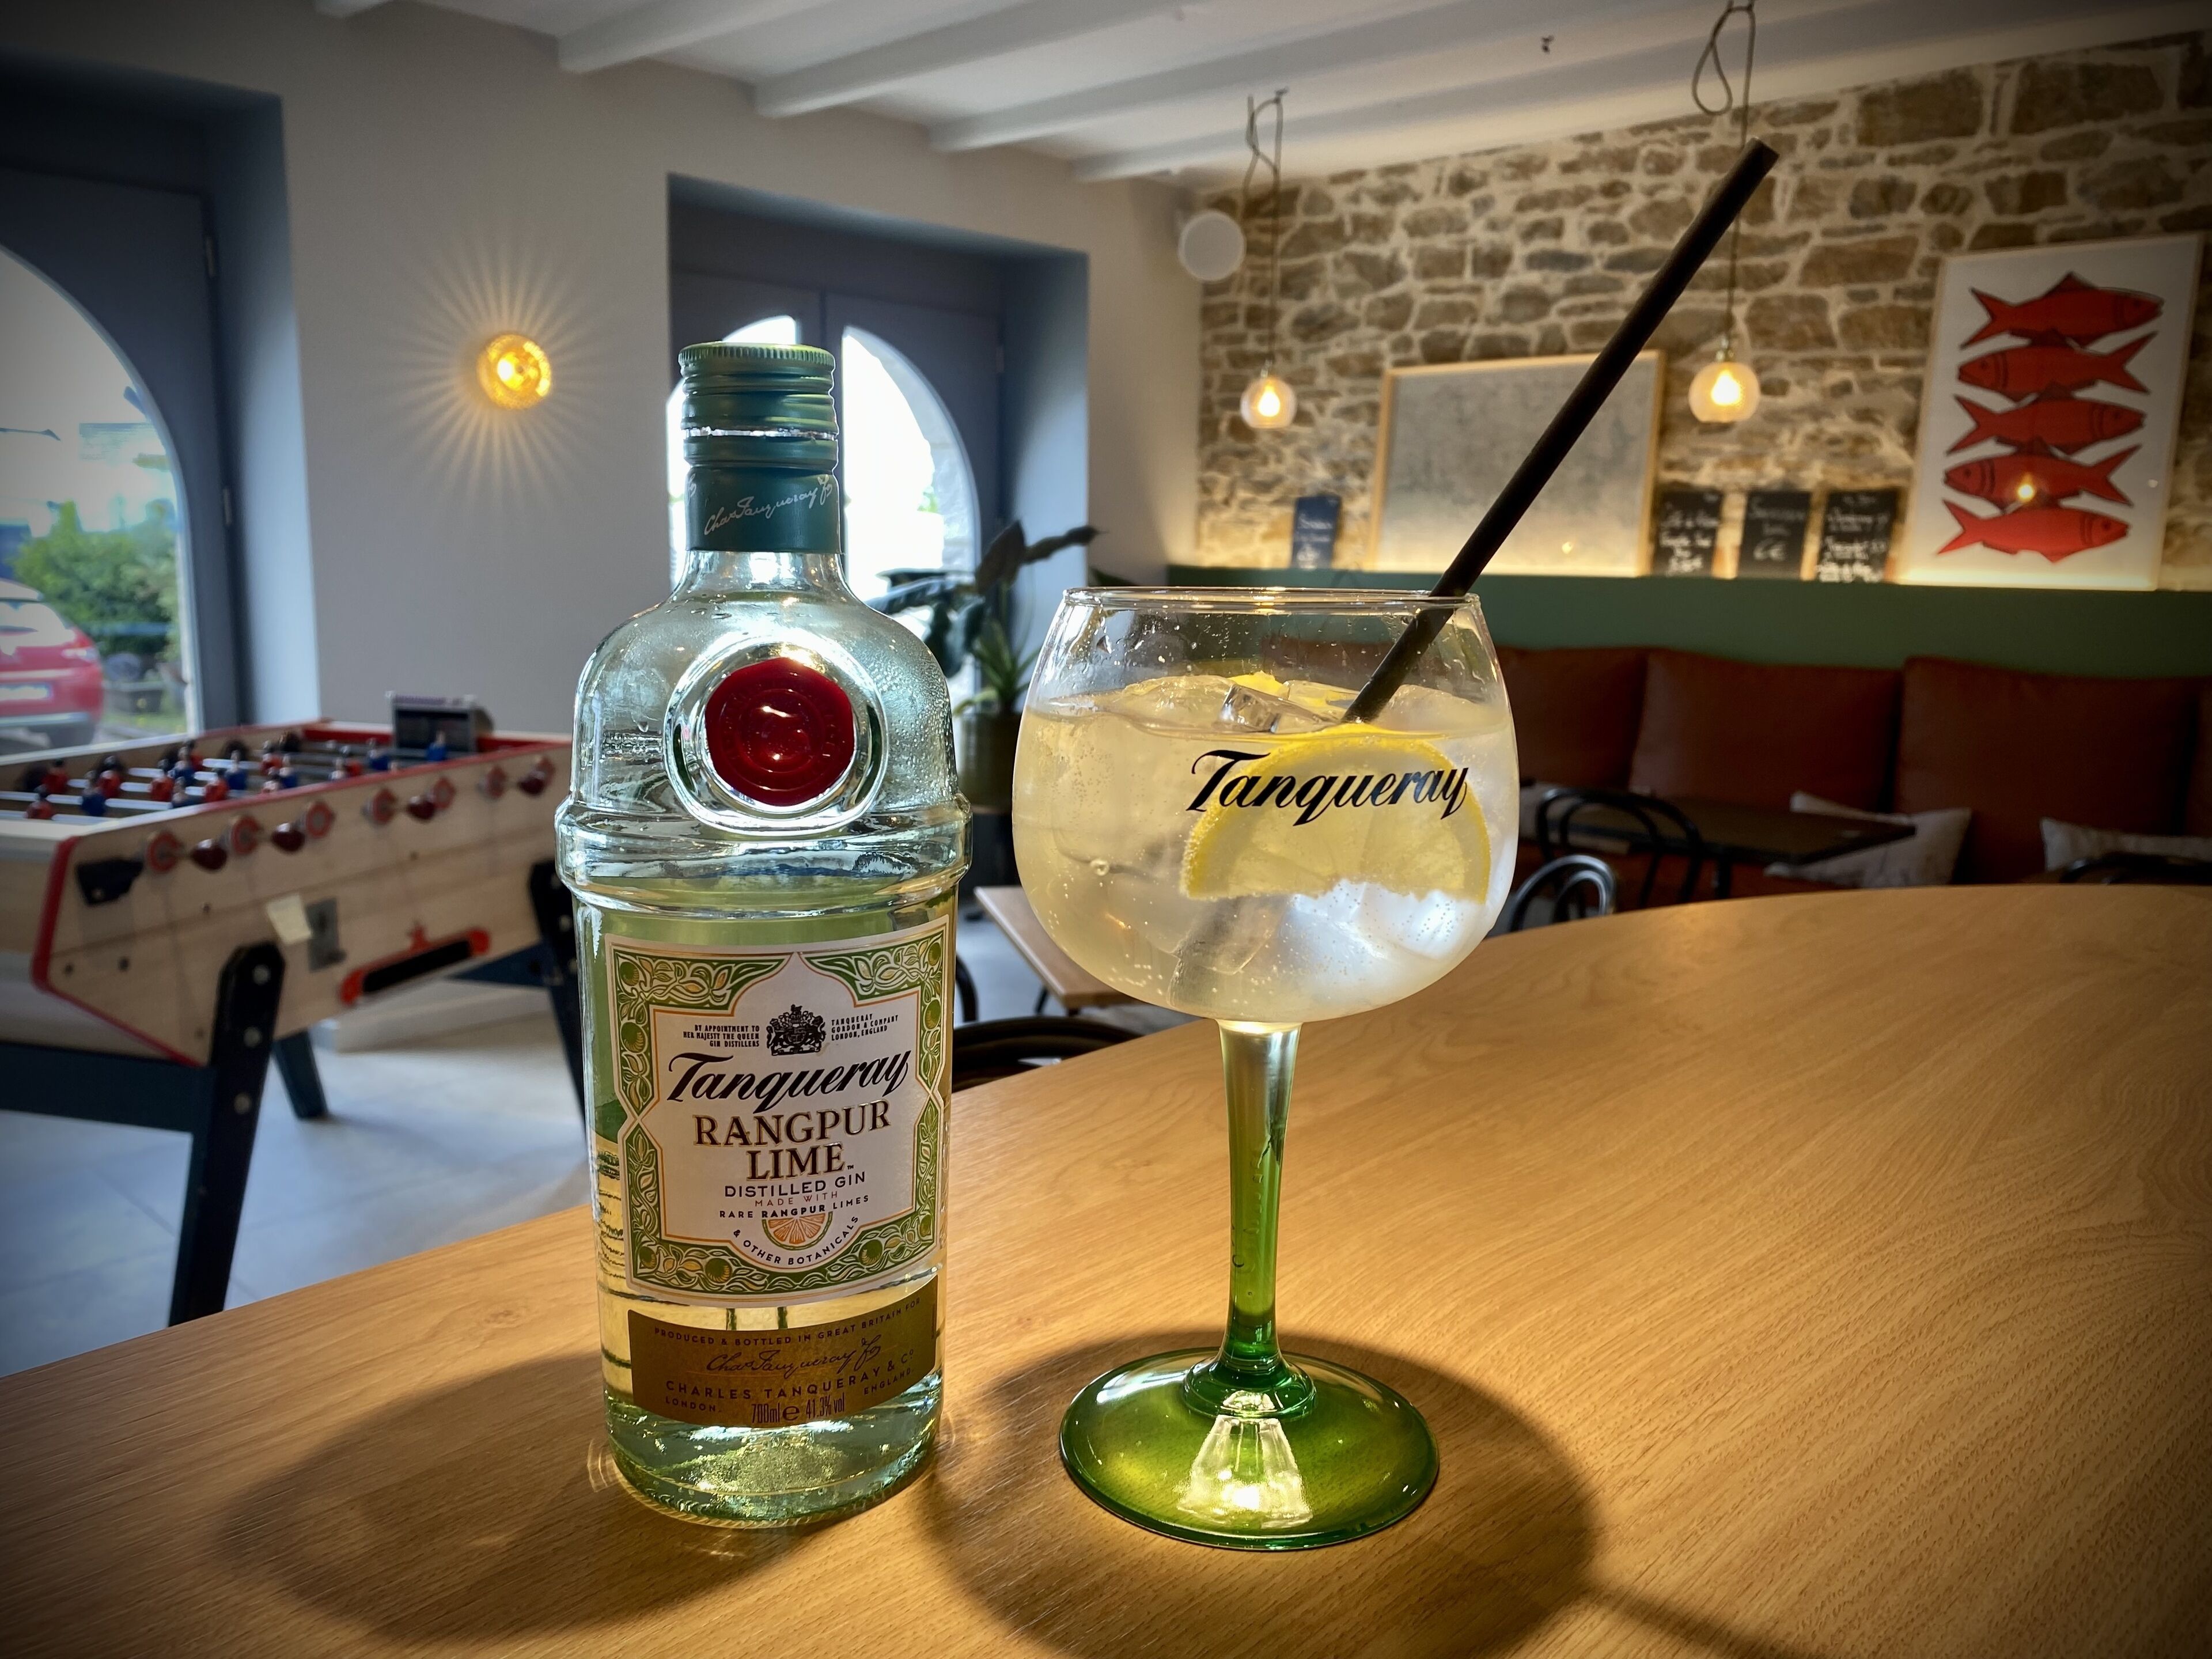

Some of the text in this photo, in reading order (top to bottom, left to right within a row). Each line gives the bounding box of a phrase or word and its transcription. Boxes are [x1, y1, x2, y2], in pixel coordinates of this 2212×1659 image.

[1185, 749, 1469, 826] Tanqueray
[831, 1013, 873, 1026] TANQUERAY
[831, 1023, 860, 1033] GORDON
[870, 1014, 899, 1027] COMPANY
[831, 1025, 888, 1041] LONDON, ENGLAND
[696, 1032, 719, 1040] MAJESTY
[667, 1050, 911, 1114] Tanqueray
[693, 1099, 891, 1147] RANGPUR
[746, 1142, 846, 1182] LIME
[725, 1171, 865, 1198] DISTILLED GIN
[755, 1191, 838, 1207] MADE WITH
[719, 1195, 869, 1218] RARE RANGPUR LIMES
[733, 1215, 858, 1265] & OTHER BOTANICALS
[654, 1297, 921, 1346] PRODUCED & BOTTLED IN GREAT BRITAIN FOR
[666, 1380, 752, 1399] CHARLES
[764, 1366, 881, 1400] TANQUERAY
[887, 1360, 895, 1372] &
[751, 1403, 780, 1423] 700ml
[806, 1394, 832, 1419] 41.3%
[834, 1392, 844, 1413] vol
